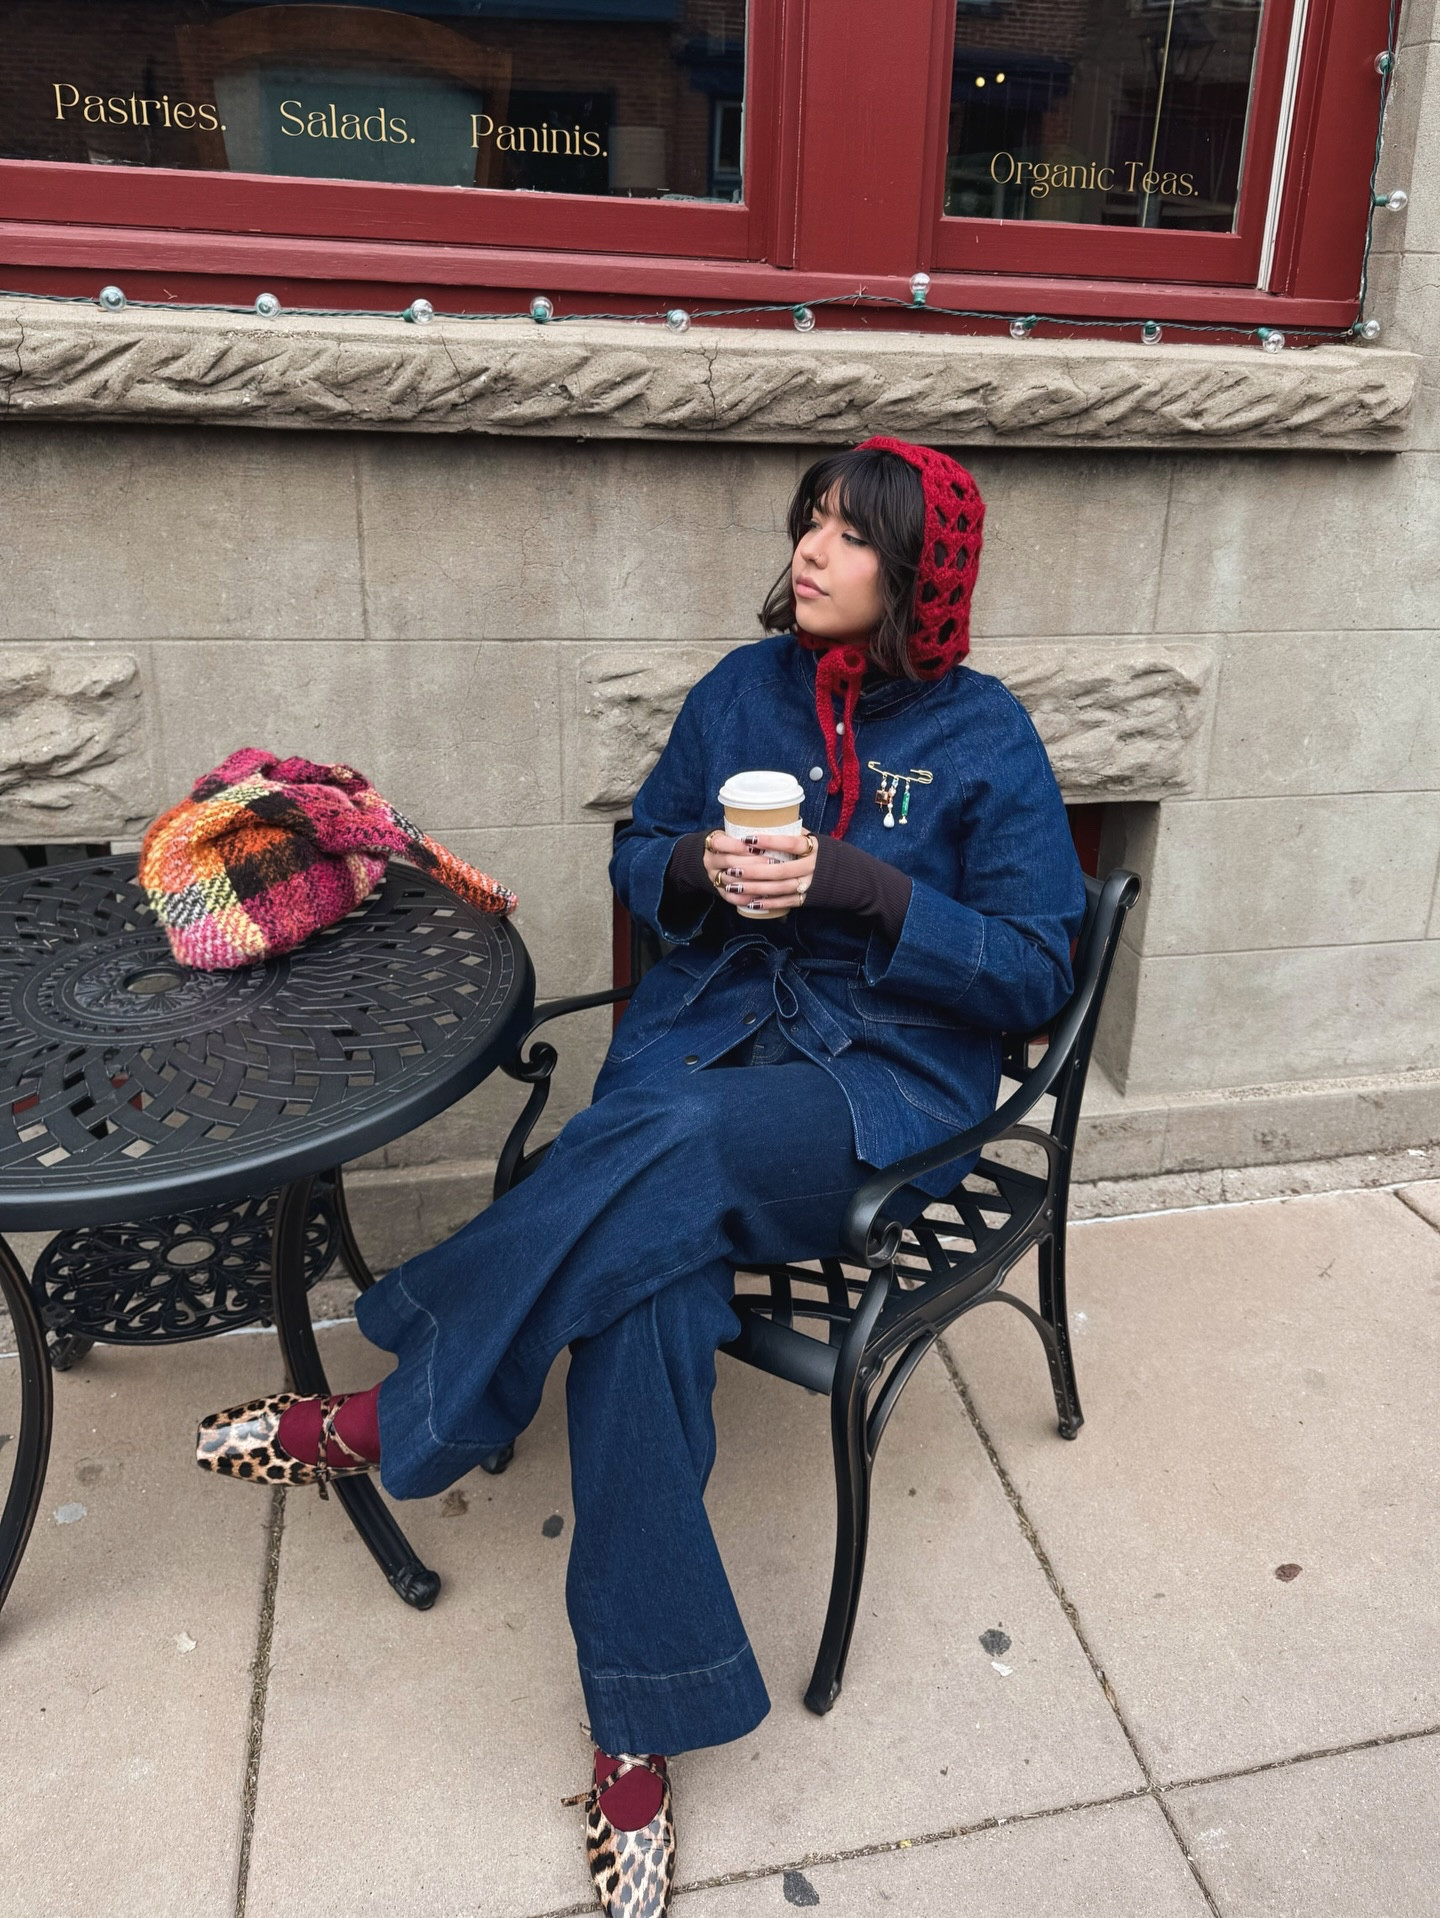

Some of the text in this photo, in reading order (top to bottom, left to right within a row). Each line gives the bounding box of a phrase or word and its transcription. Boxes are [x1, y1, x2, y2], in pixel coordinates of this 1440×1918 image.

[52, 83, 608, 157] Pastries. Salads. Paninis.
[990, 151, 1200, 199] Organic Teas.
